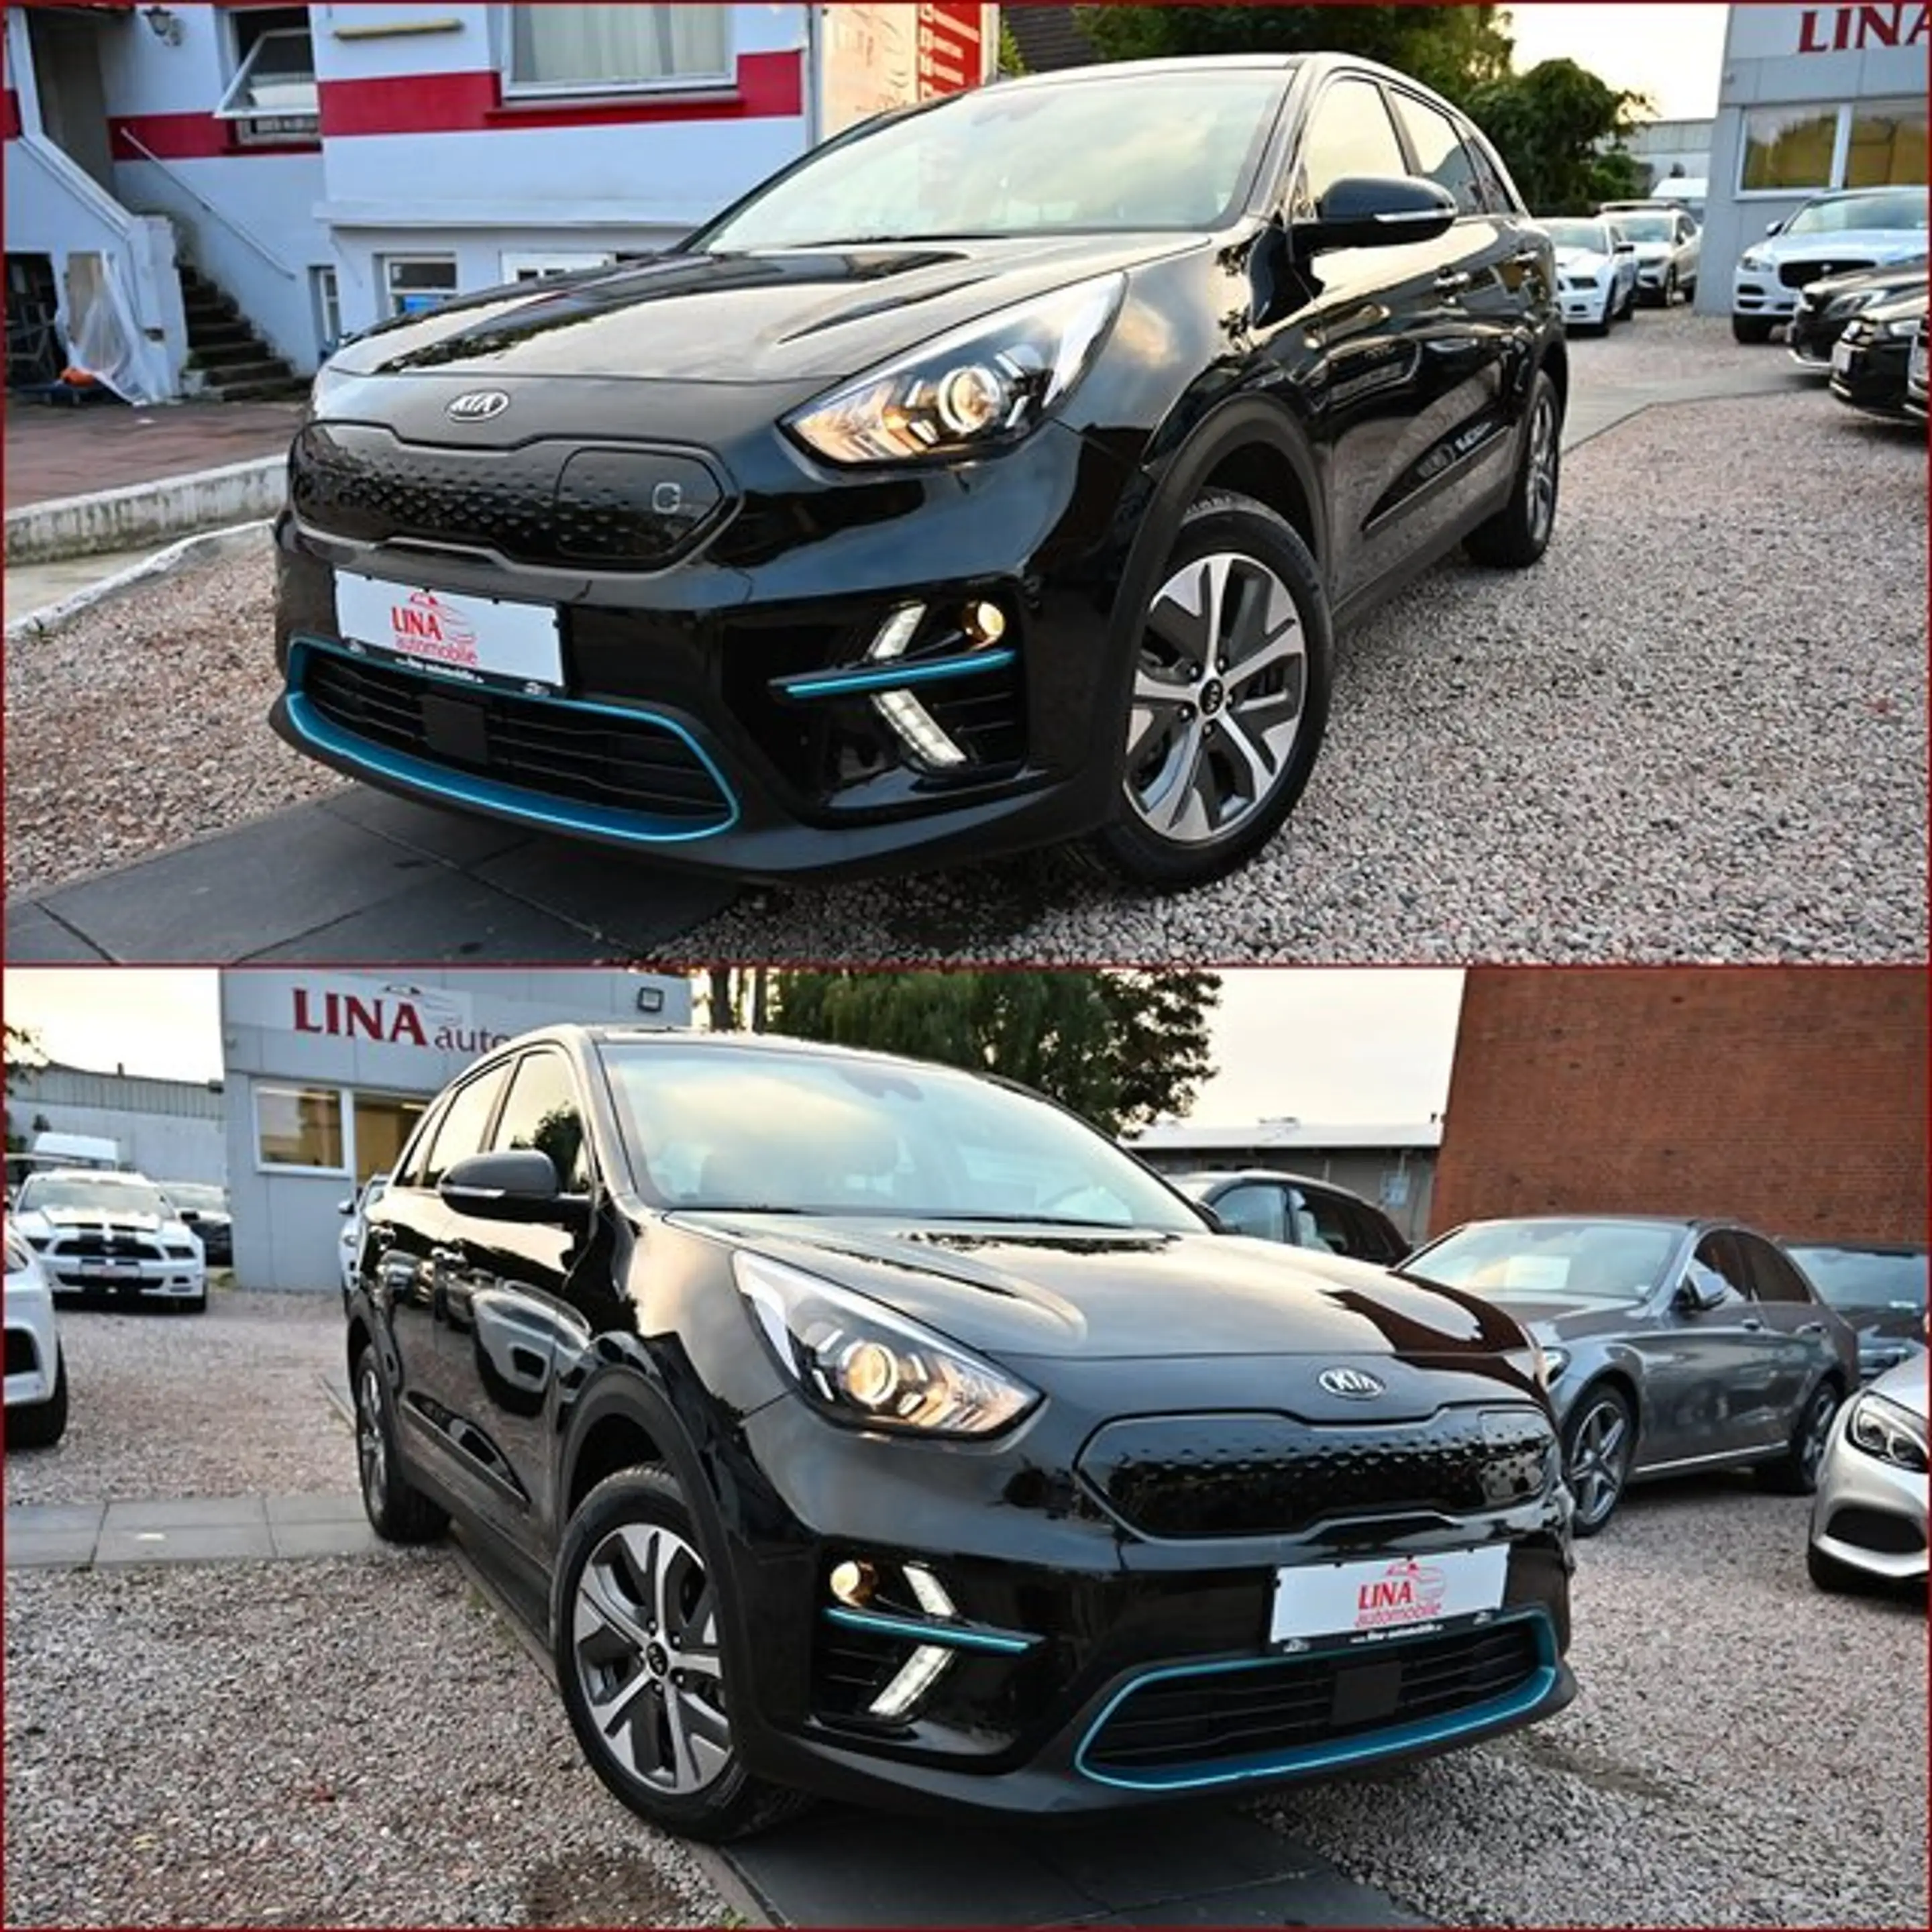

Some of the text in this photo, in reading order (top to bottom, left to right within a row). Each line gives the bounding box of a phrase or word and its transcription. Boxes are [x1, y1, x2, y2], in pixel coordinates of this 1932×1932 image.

[391, 606, 443, 641] LINA
[292, 987, 429, 1046] LINA
[1358, 1580, 1412, 1610] LINA
